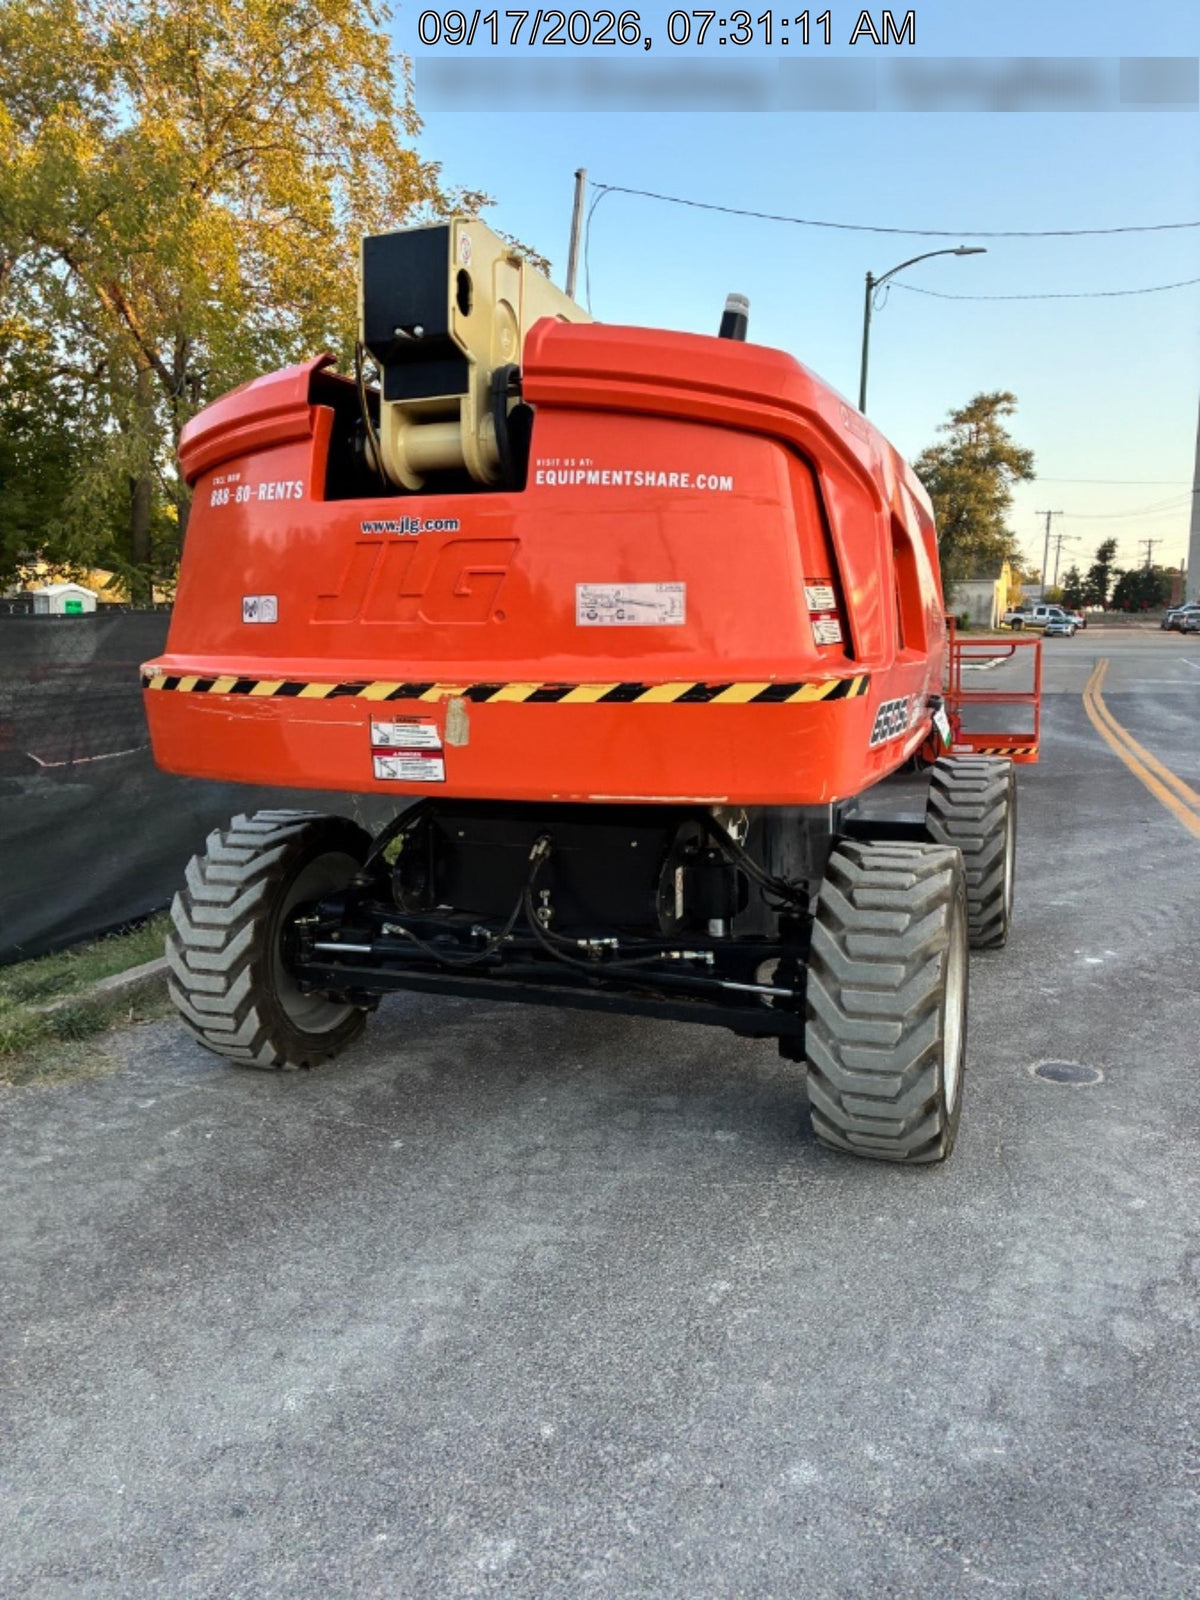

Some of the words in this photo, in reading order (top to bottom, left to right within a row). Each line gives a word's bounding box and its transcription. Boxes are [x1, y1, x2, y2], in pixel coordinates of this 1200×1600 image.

[536, 458, 560, 466] VISIT
[564, 458, 576, 466] US
[535, 470, 734, 491] EQUIPMENTSHARE.COM
[210, 480, 304, 506] 888-80-RENTS
[361, 516, 459, 534] www.jlg.com
